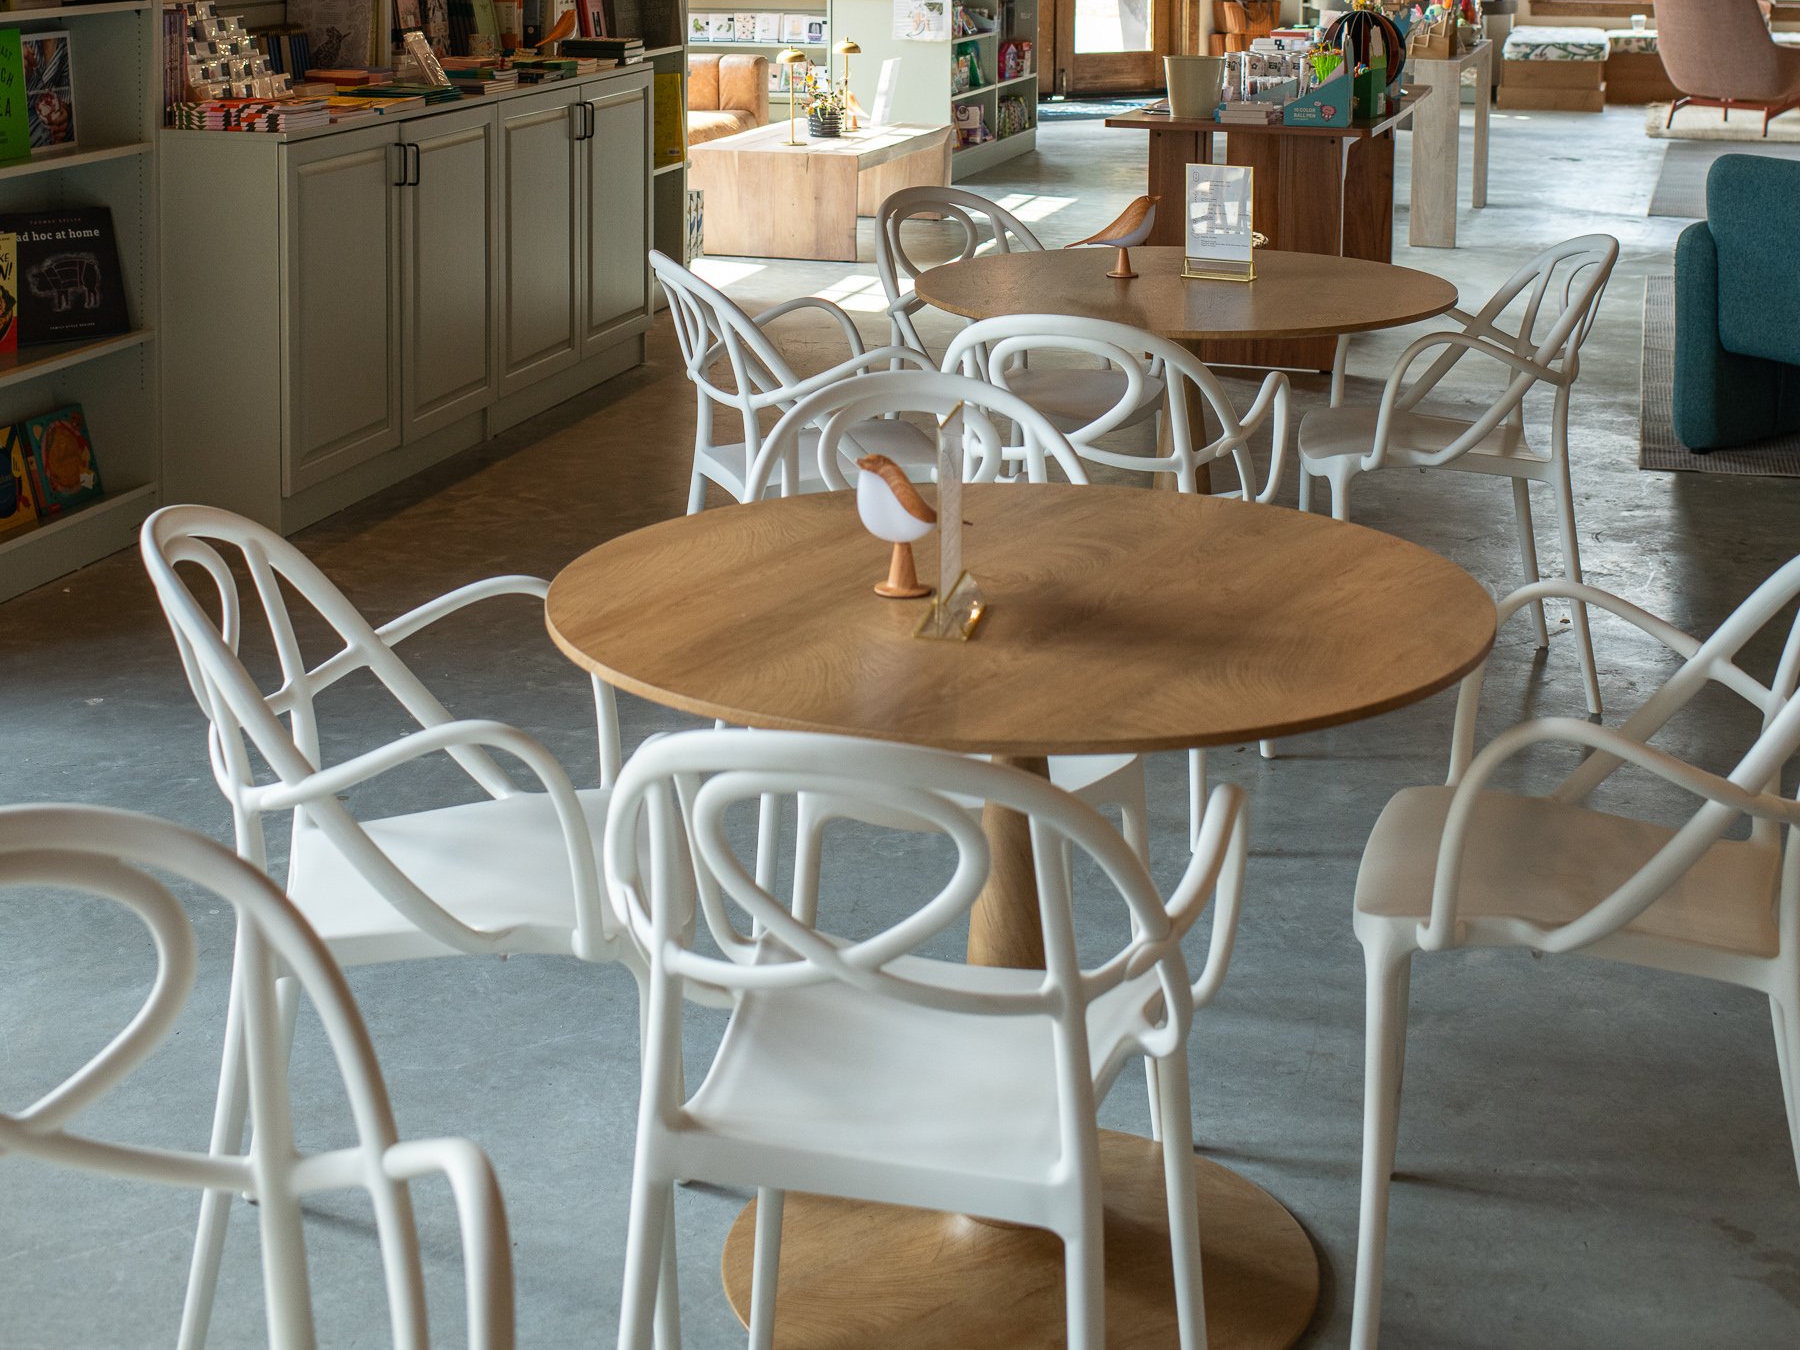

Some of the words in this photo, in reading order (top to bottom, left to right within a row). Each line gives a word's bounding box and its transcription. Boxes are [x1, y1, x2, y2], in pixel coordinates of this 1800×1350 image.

[16, 232, 30, 242] ad
[32, 231, 53, 242] hoc
[55, 230, 66, 240] at
[68, 228, 100, 238] home
